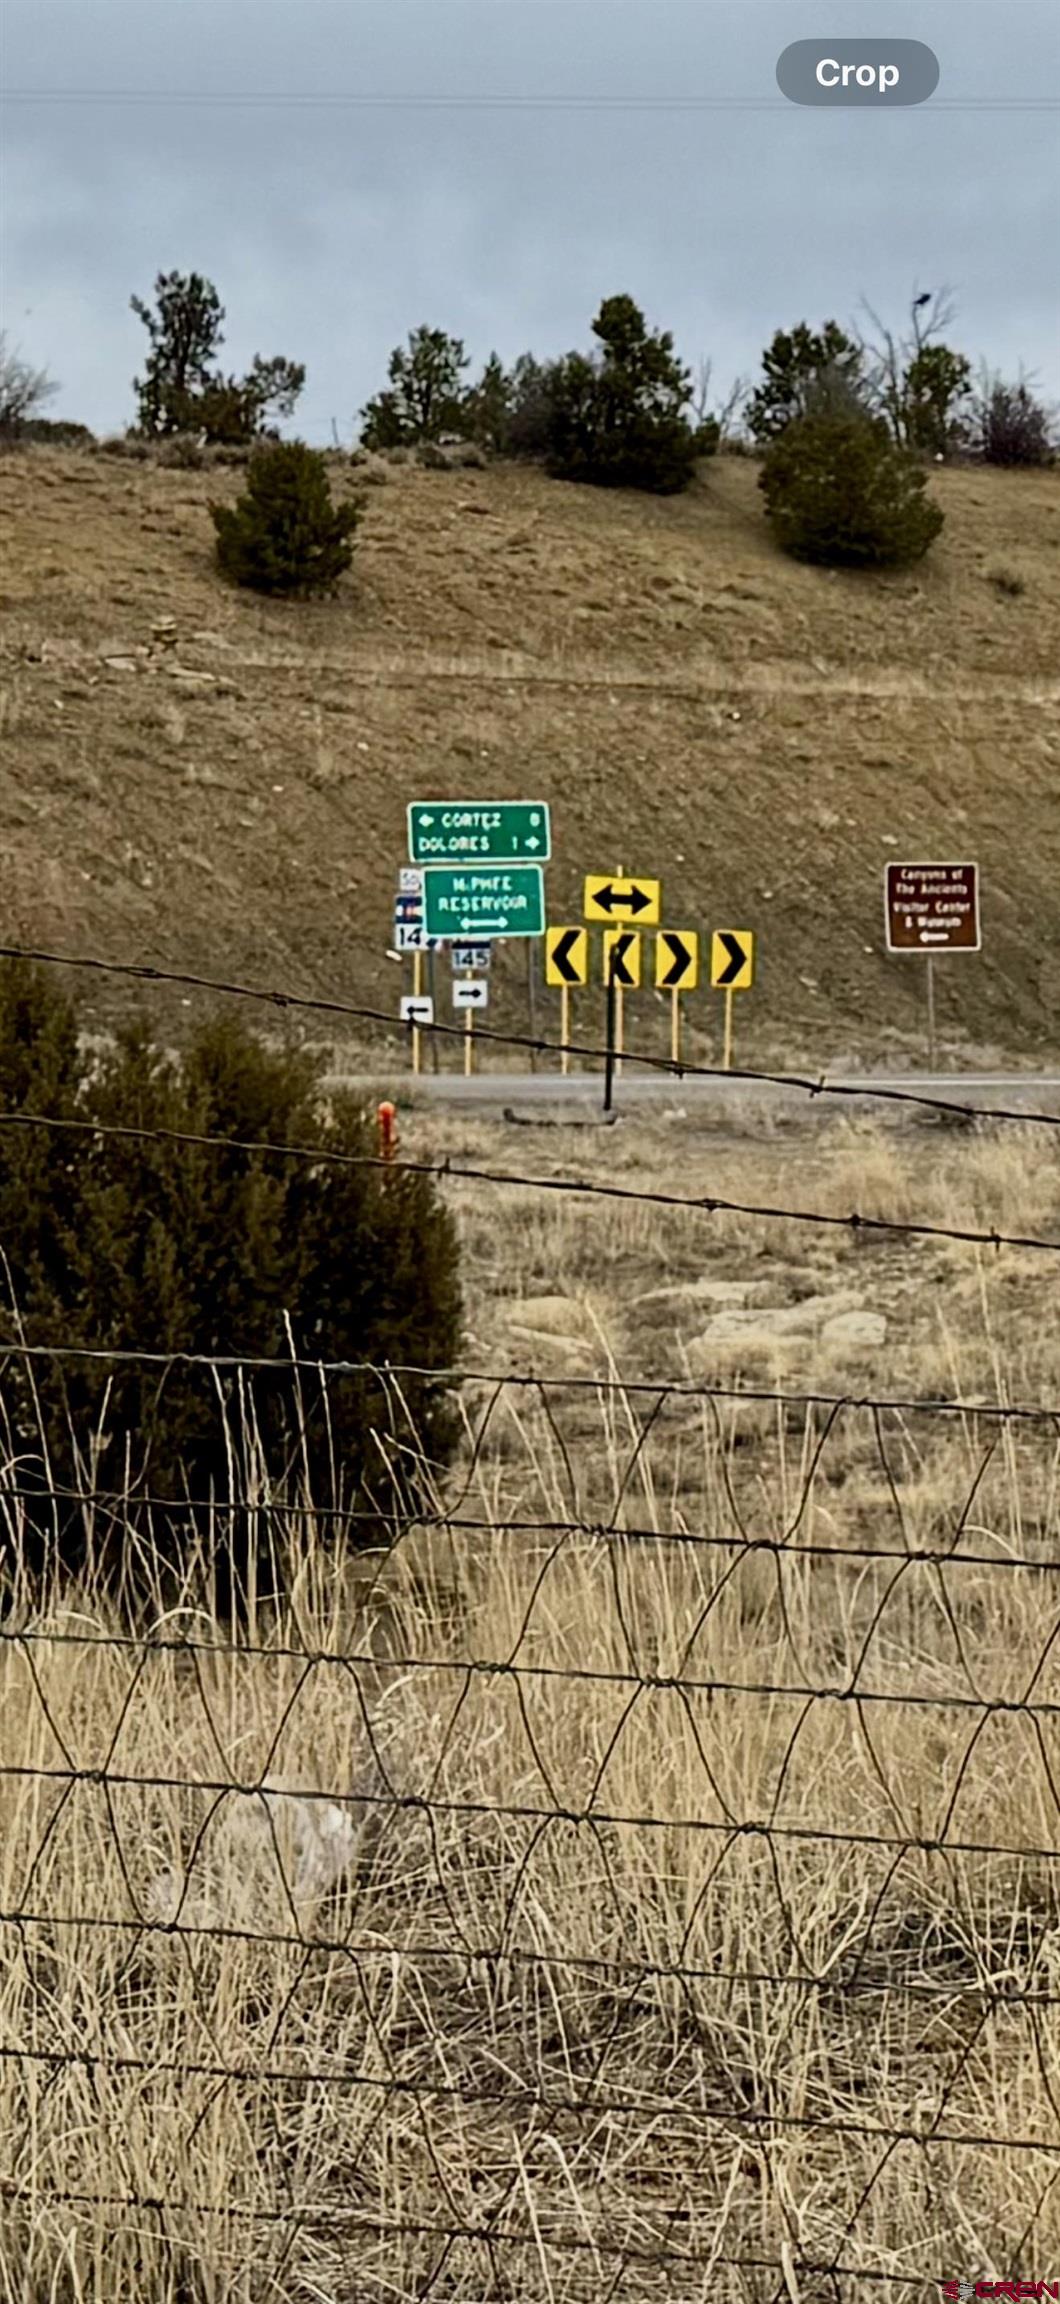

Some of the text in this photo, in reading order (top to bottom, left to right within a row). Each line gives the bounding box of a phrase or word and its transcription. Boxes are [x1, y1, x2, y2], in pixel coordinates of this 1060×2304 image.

[441, 812, 502, 829] CORTEZ
[418, 836, 518, 852] DOLORES 1
[900, 868, 964, 881] Canyons of
[895, 883, 915, 895] The
[438, 895, 527, 913] RESERVOIR
[893, 901, 971, 914] Visitor Center
[455, 951, 489, 967] 145
